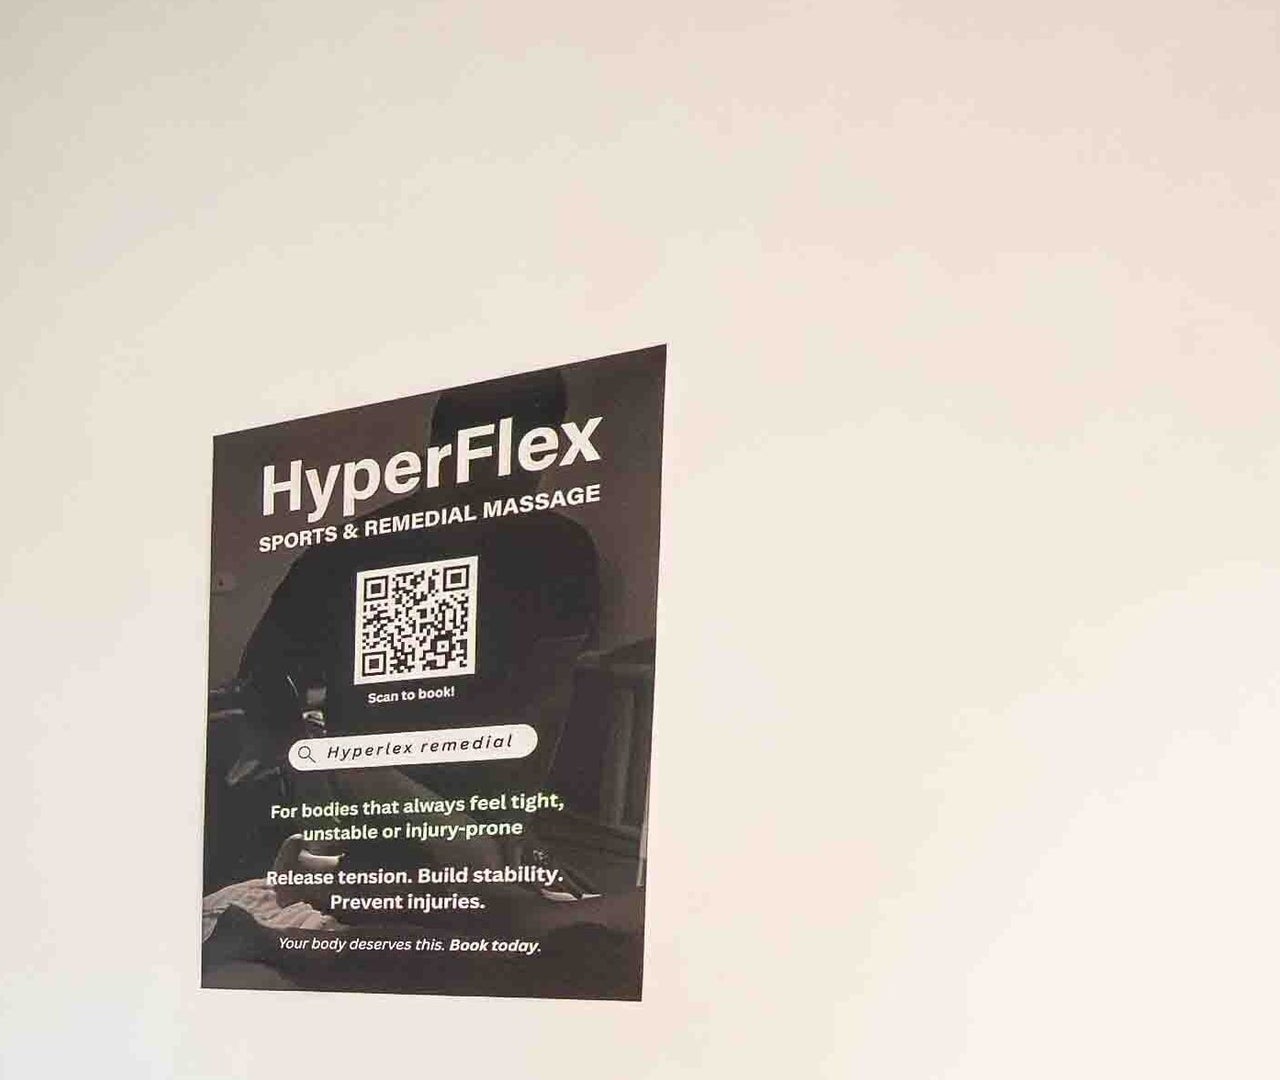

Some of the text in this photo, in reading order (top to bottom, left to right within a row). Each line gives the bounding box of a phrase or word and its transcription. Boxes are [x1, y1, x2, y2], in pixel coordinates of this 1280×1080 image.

[262, 416, 604, 522] HyperFlex
[259, 484, 601, 553] SPORTS & REMEDIAL MASSAGE
[368, 686, 455, 703] Scan to book!
[327, 734, 513, 761] Hyperlex remedial
[271, 793, 564, 819] For bodies that always feel tight,
[303, 821, 523, 840] unstable or injury-prone
[266, 866, 563, 886] Release tension. Build stability.
[330, 893, 485, 913] Prevent injuries.
[279, 936, 541, 955] Your body deserves this. Book today.
